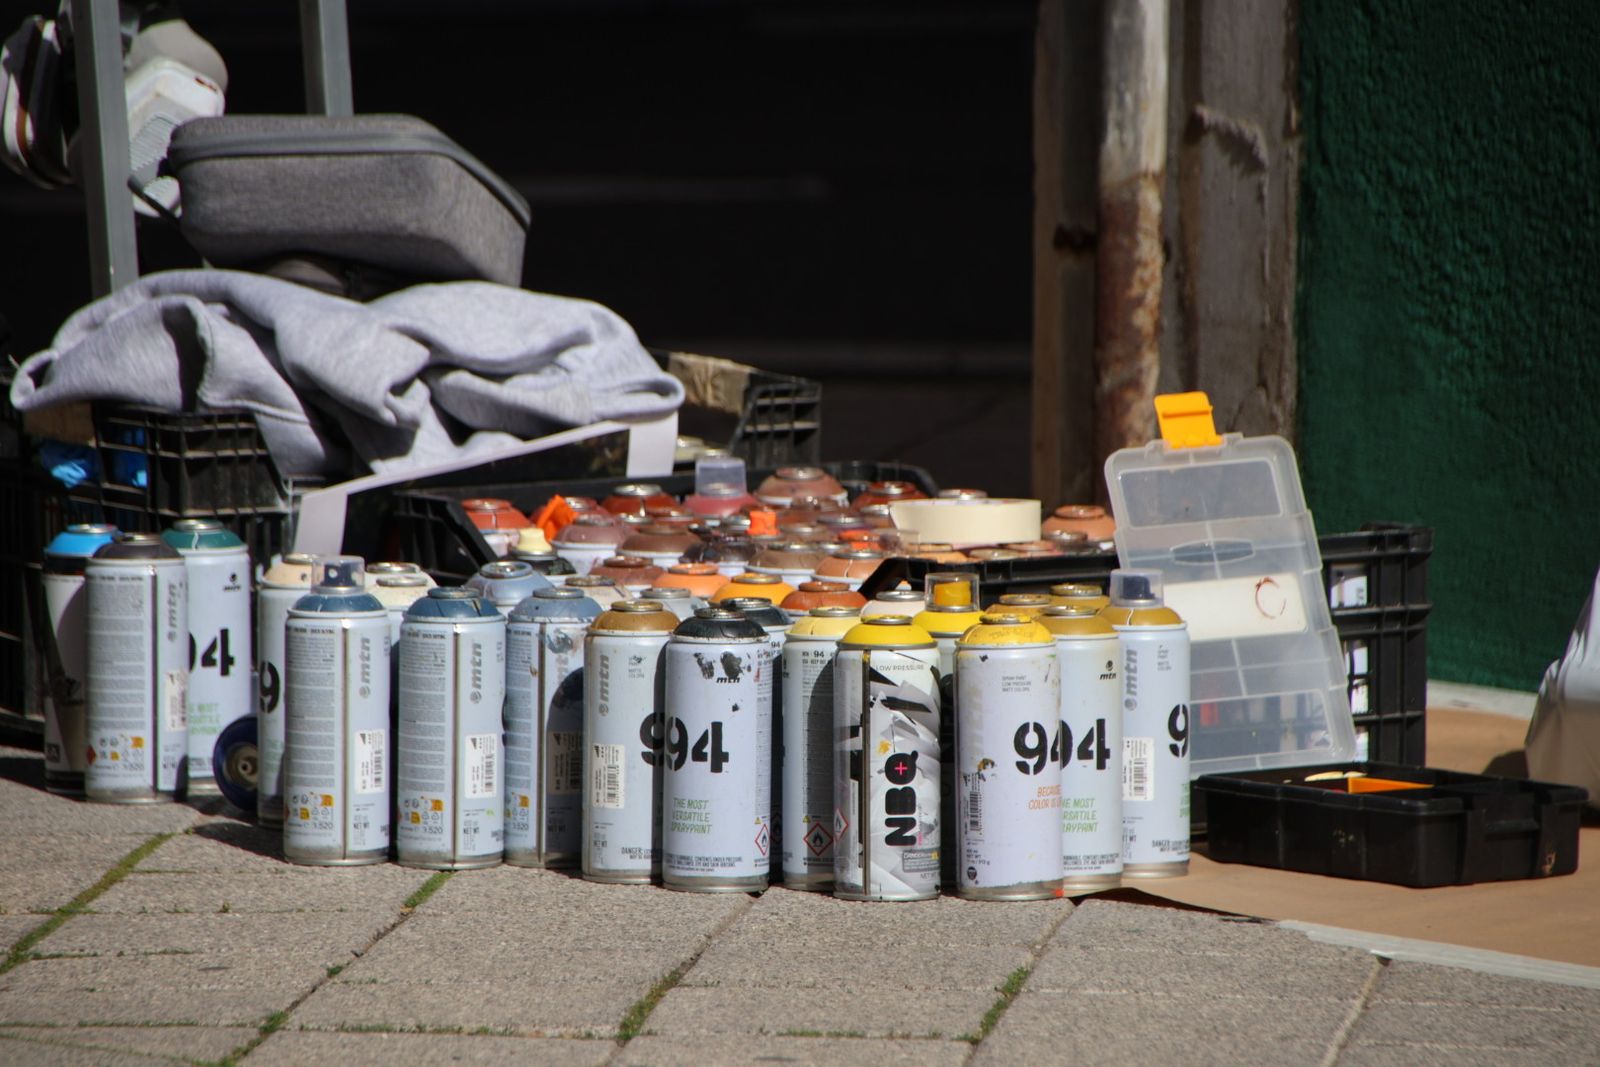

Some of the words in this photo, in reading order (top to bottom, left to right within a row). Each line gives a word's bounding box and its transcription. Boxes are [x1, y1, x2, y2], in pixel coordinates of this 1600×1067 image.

[813, 650, 825, 658] 94
[360, 637, 371, 684] mtn
[470, 643, 482, 690] mtn
[1100, 672, 1116, 680] mtn
[1125, 649, 1137, 696] mtn
[1168, 704, 1189, 758] 9
[665, 716, 729, 773] 94
[686, 799, 709, 809] MOST
[1072, 798, 1095, 809] MOST
[1063, 810, 1097, 820] RSATILE
[1063, 822, 1099, 833] AYPAINT
